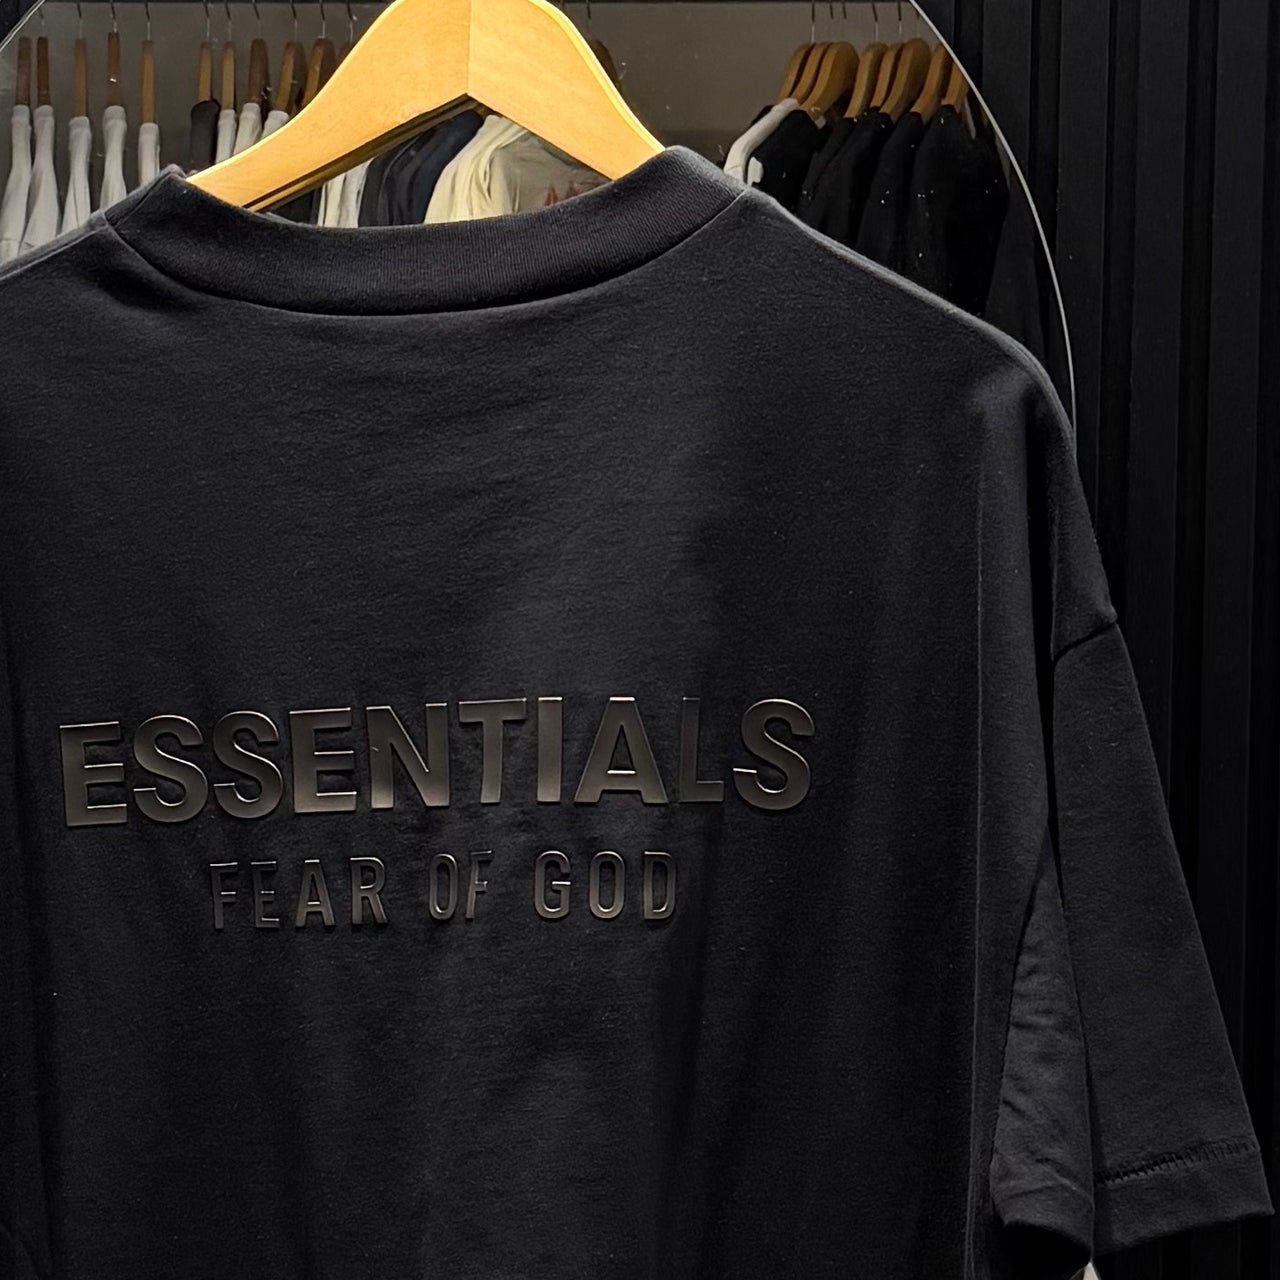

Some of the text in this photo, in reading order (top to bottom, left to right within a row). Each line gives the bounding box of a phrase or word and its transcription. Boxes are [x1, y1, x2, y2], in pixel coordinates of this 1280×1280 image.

[59, 696, 816, 827] ESSENTIALS
[209, 850, 677, 929] FEAR OF GOD
